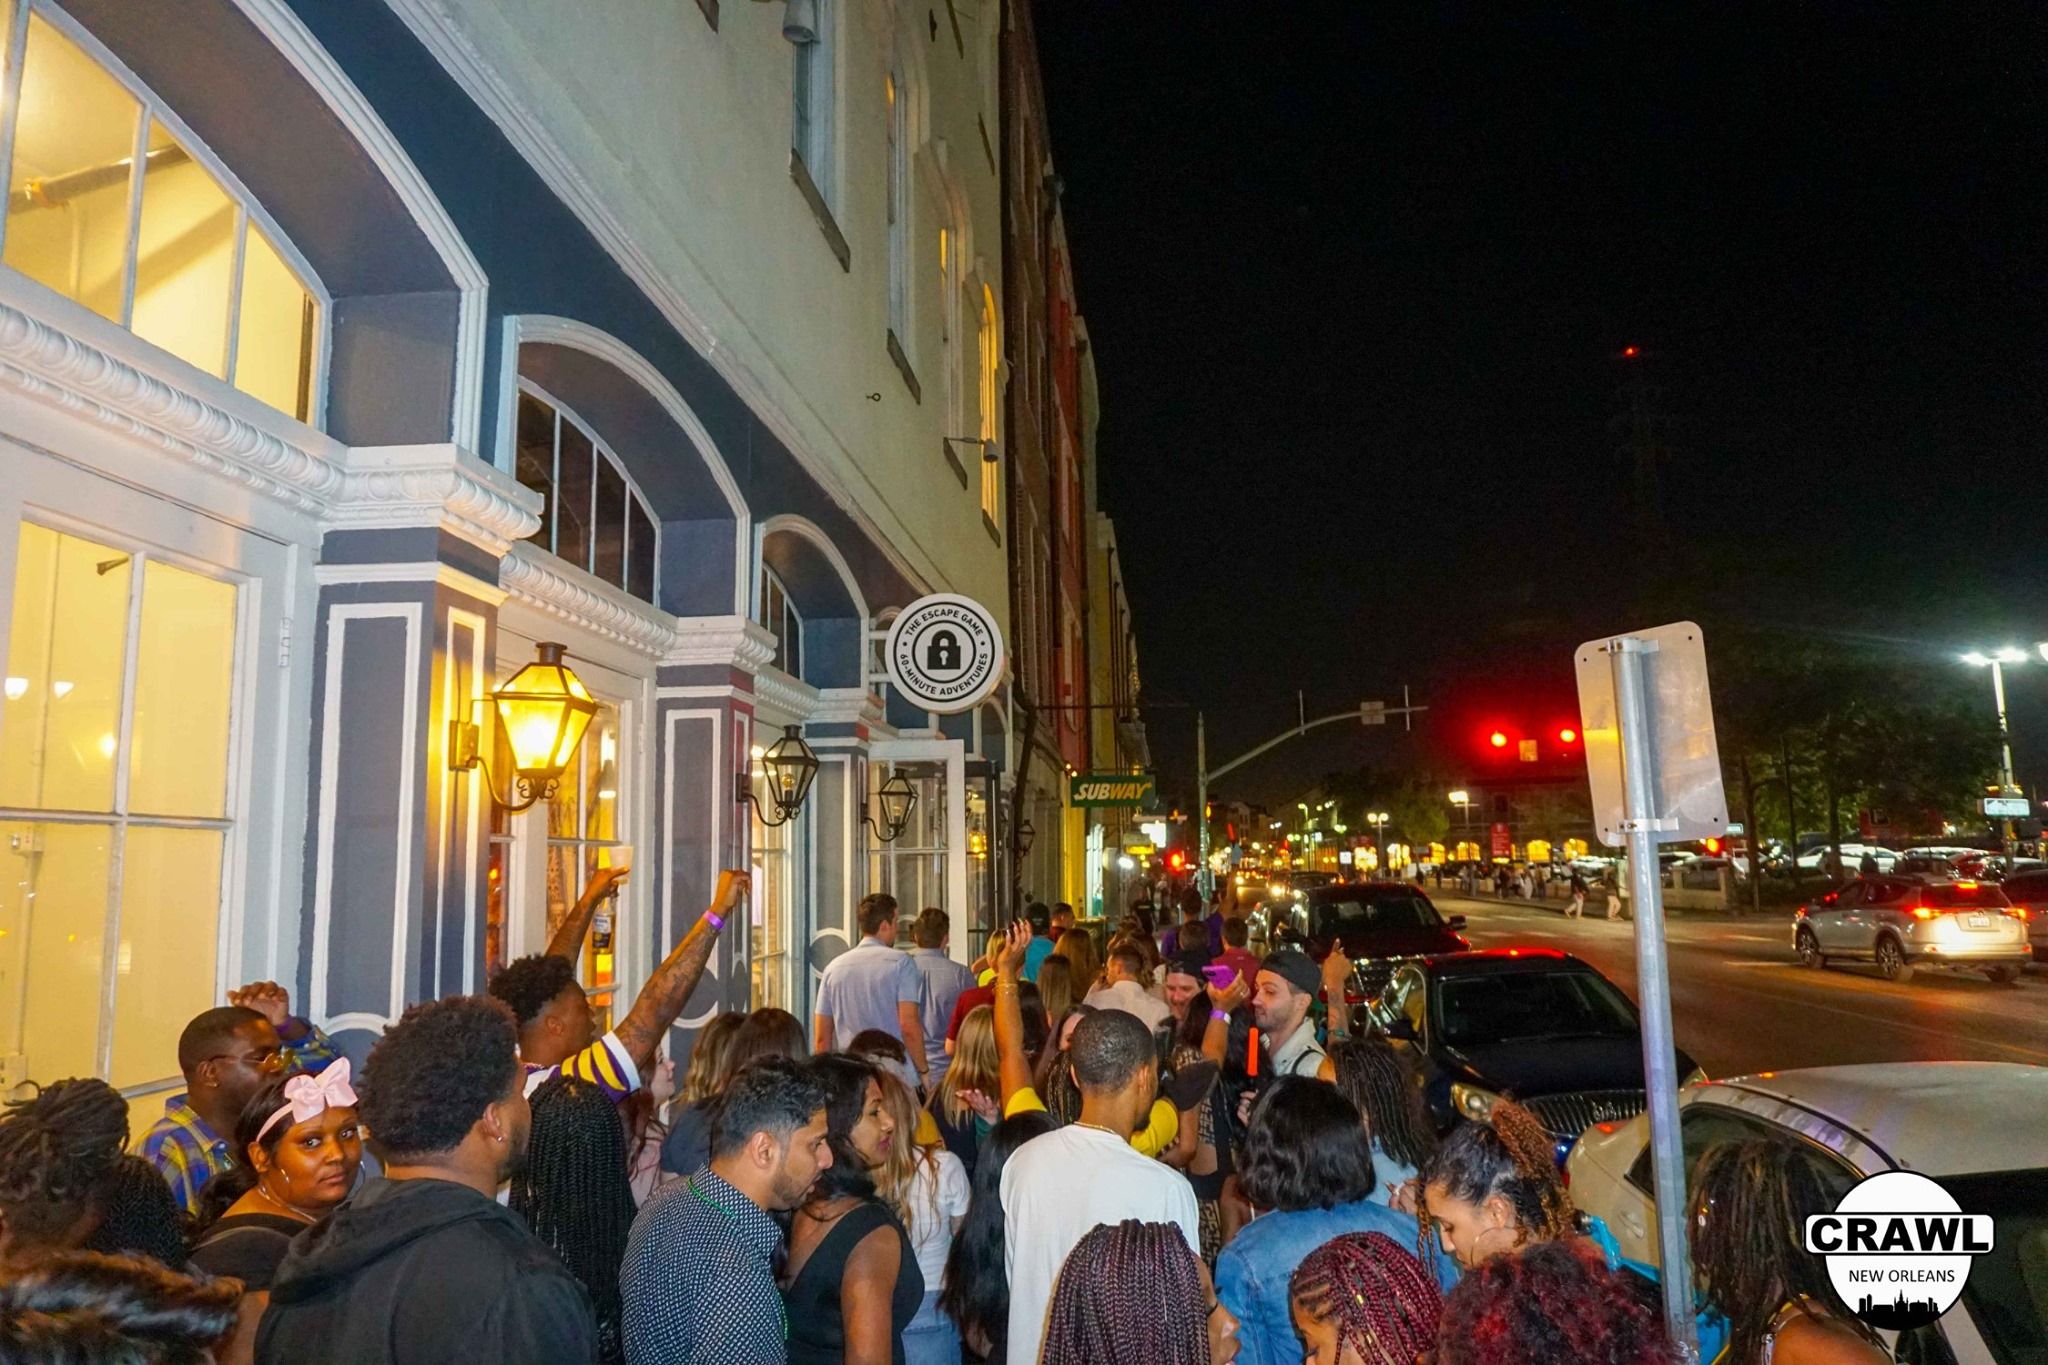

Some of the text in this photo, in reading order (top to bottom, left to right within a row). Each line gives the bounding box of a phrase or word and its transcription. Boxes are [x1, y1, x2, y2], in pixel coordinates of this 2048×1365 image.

[905, 608, 984, 637] THE ESCAPE GAME
[900, 652, 988, 696] 60-MINUTE ADVENTURES
[1073, 782, 1152, 801] SUBWAY
